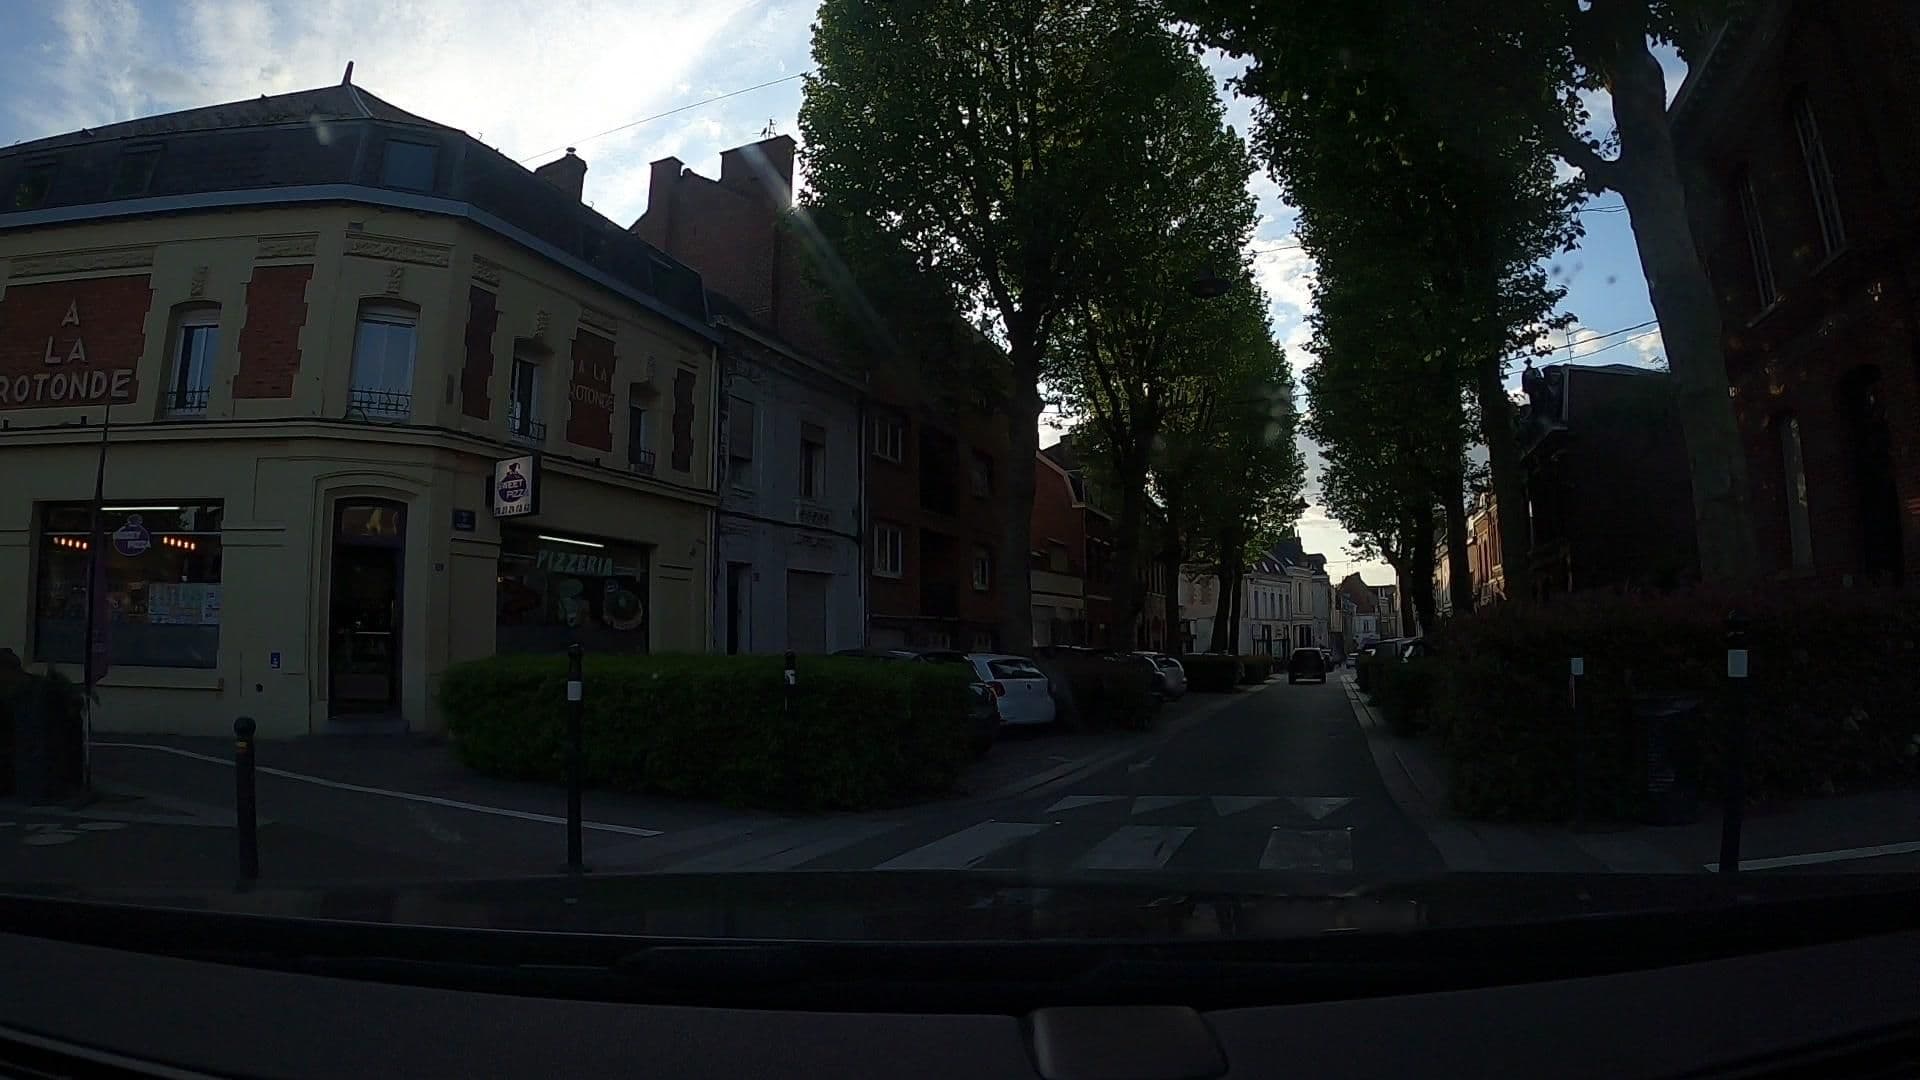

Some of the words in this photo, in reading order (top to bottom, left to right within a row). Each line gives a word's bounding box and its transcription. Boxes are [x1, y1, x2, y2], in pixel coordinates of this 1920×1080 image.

[61, 297, 80, 327] A
[44, 335, 86, 363] LA
[0, 369, 133, 403] ROTONDE
[577, 359, 585, 373] A
[592, 362, 607, 385] LA
[536, 550, 614, 576] PIZZERIA
